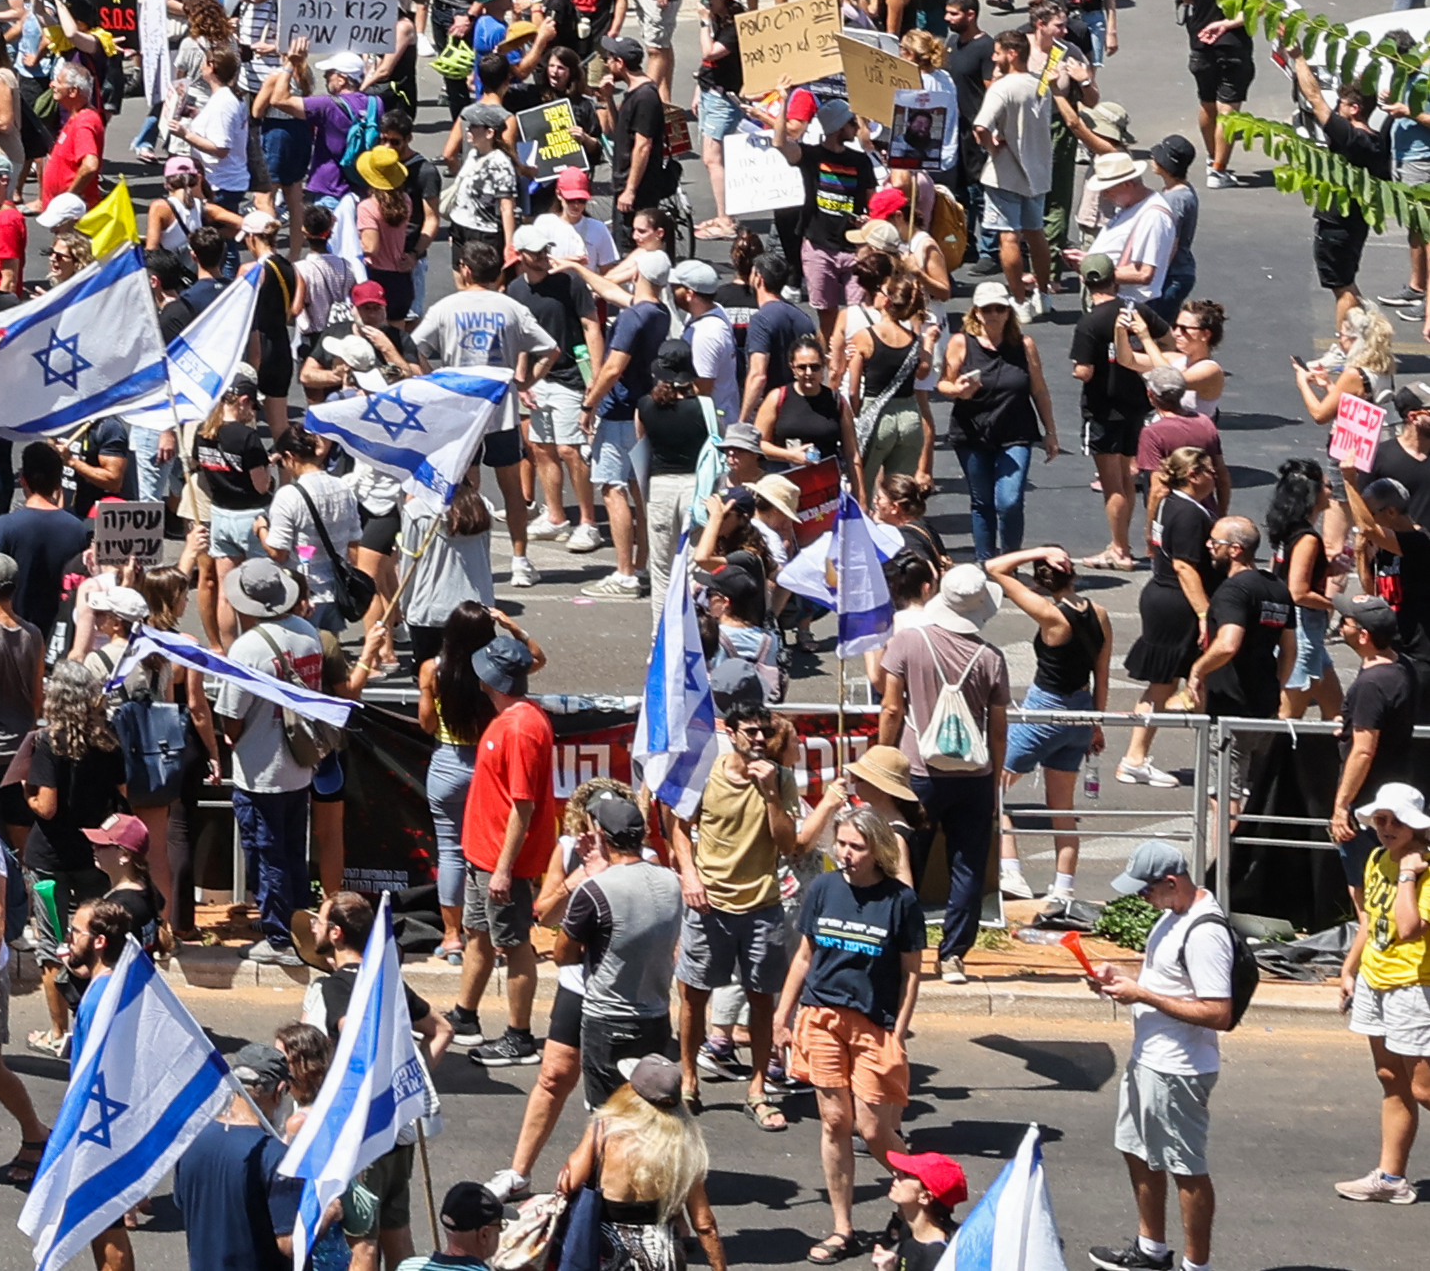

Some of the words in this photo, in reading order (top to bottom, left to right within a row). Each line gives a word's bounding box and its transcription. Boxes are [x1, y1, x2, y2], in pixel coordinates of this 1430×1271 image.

[99, 8, 136, 31] S.O.S
[346, 0, 388, 20] הוא
[542, 103, 570, 121] איפה
[546, 129, 572, 146] שהם
[102, 509, 163, 532] עסקה
[96, 537, 162, 558] עכשיו!
